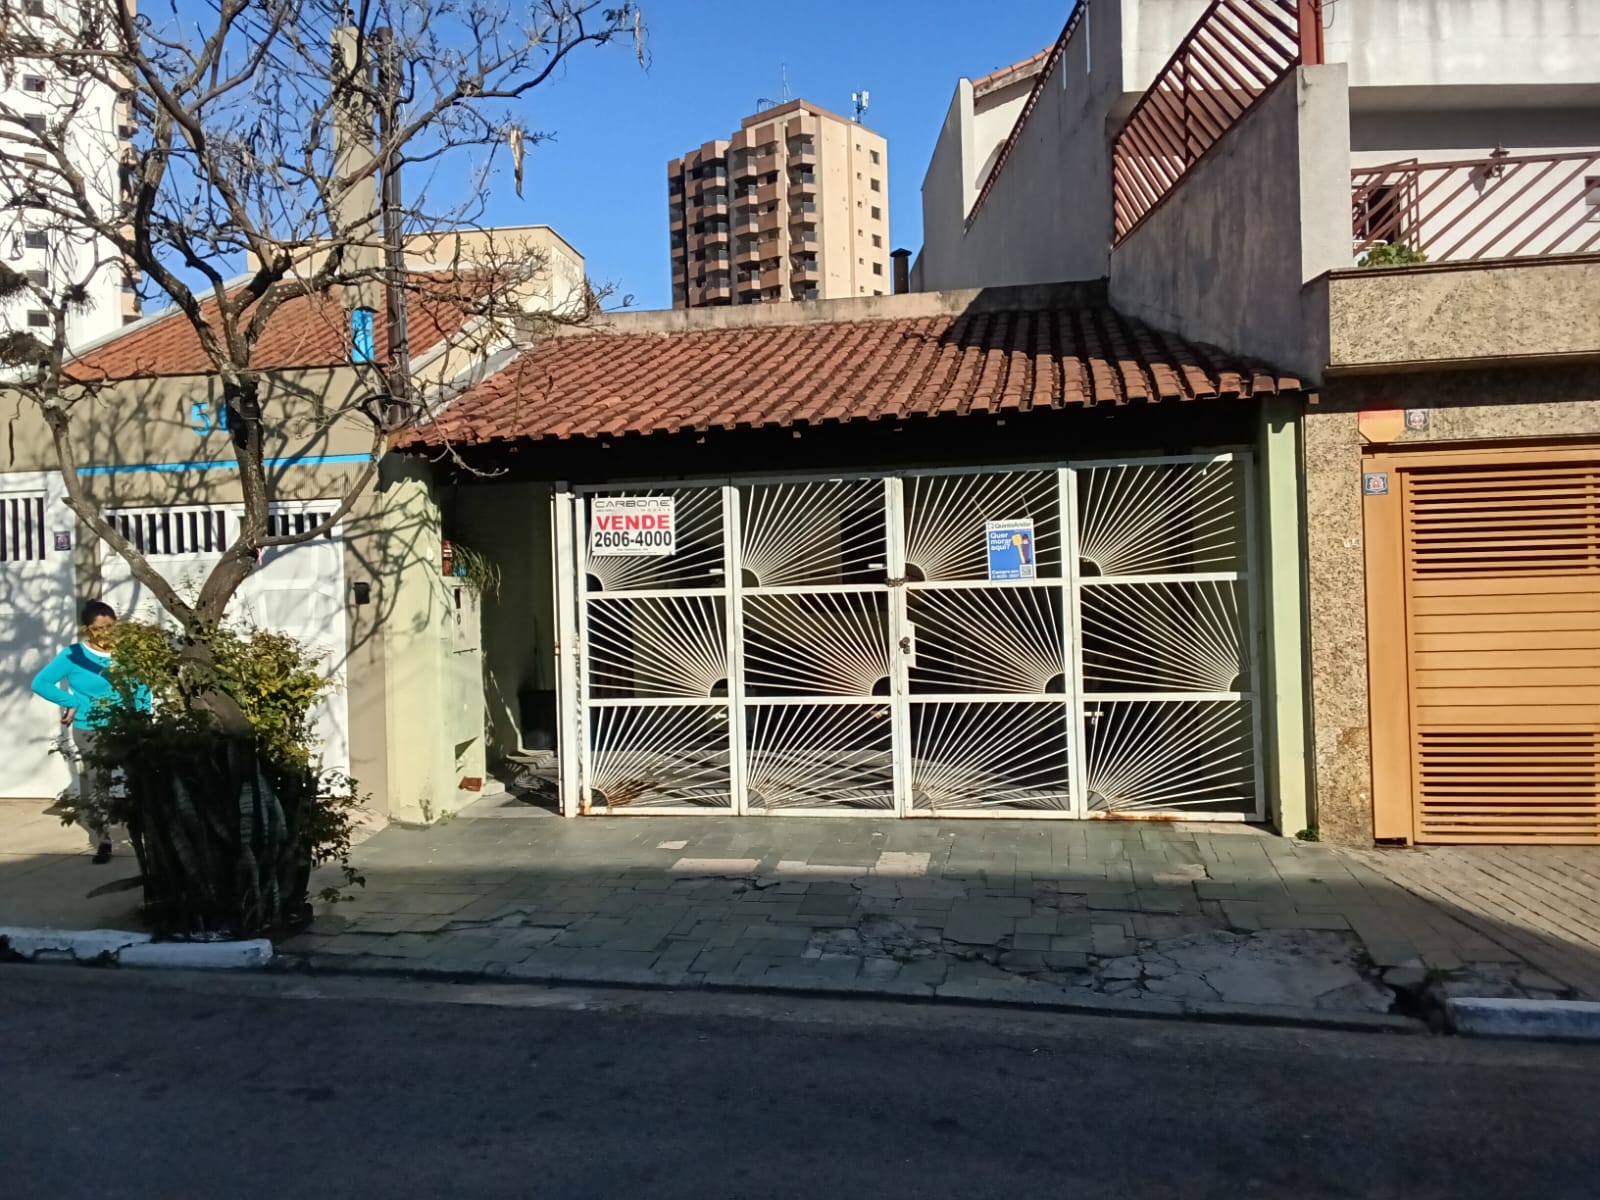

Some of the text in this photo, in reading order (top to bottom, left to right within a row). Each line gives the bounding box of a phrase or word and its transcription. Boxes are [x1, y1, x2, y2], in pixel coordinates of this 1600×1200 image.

[595, 499, 670, 508] CARBONE
[596, 515, 670, 530] VENDE
[594, 531, 672, 548] 2606-4000
